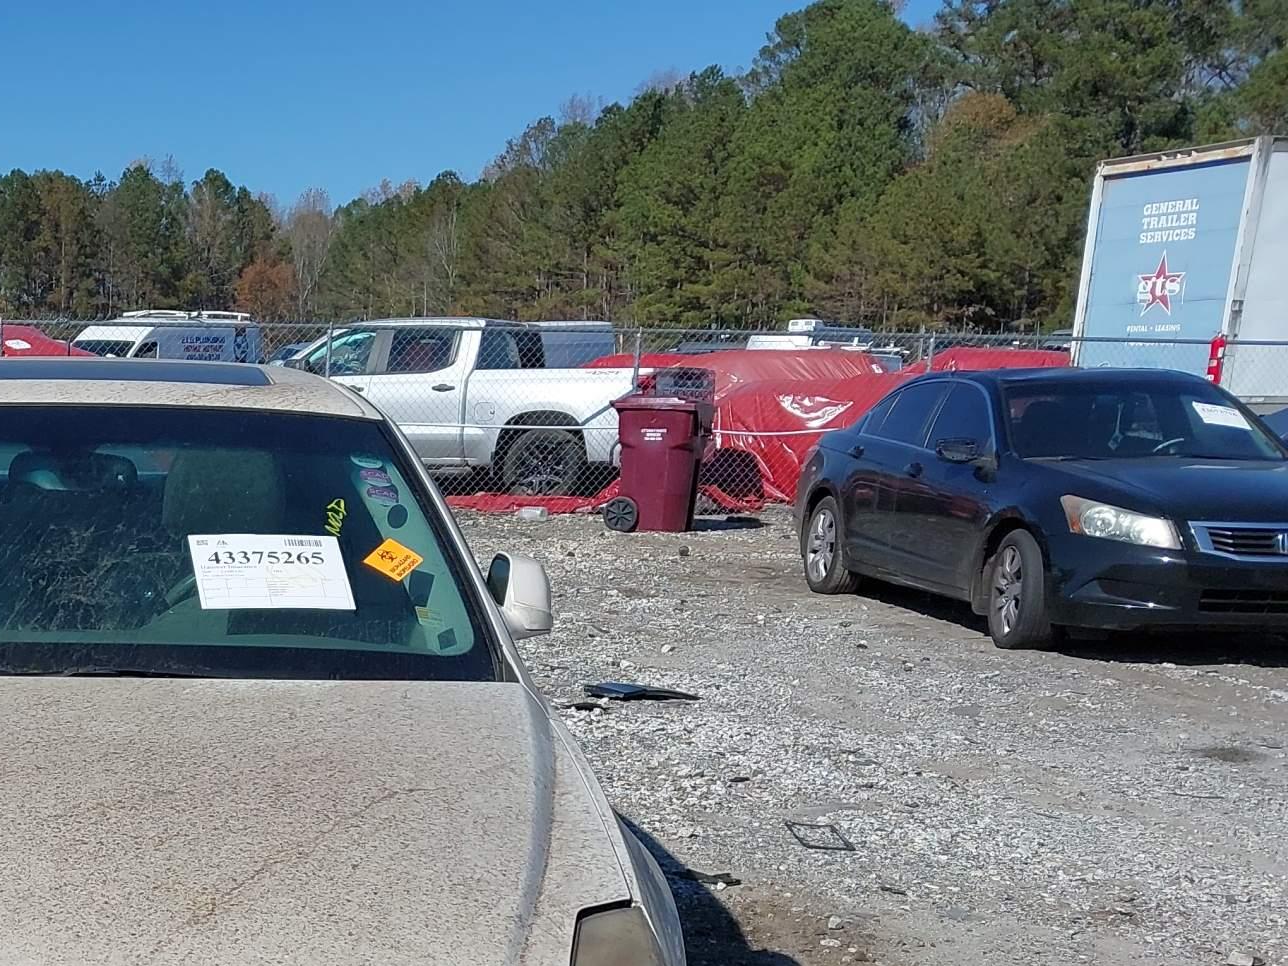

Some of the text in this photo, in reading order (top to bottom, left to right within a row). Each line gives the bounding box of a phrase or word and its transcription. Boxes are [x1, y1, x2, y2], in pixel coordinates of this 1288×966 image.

[1143, 199, 1200, 216] GENERAL
[1142, 212, 1198, 230] TRAILER
[1139, 228, 1196, 244] SERVICES
[1137, 274, 1181, 305] gts
[1126, 324, 1181, 333] RENTAL LEASING
[208, 551, 325, 565] 43375265
